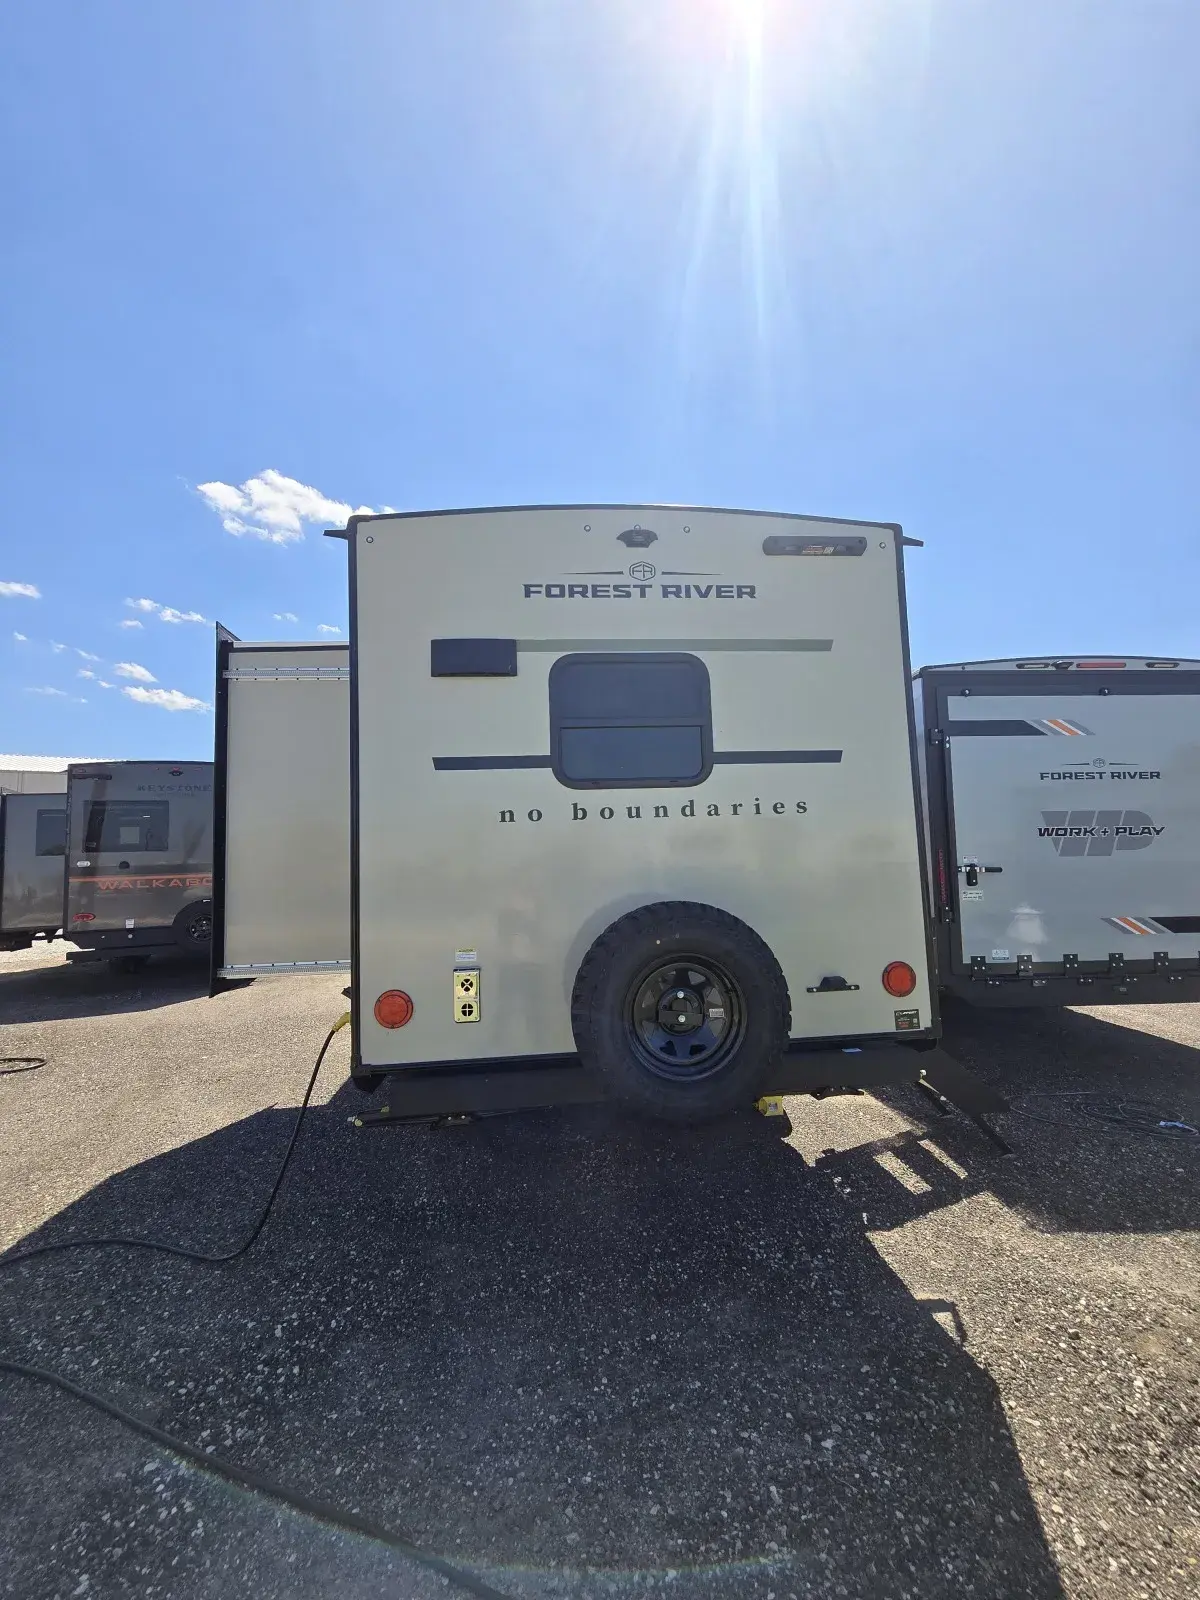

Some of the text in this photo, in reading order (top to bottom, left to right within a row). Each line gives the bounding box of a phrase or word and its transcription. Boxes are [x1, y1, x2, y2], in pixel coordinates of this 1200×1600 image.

[522, 583, 757, 599] FOREST RIVER
[1039, 771, 1161, 781] FOREST RIVER
[136, 784, 212, 792] KEYSTONE
[498, 797, 809, 823] no boundaries
[1037, 826, 1166, 837] WORK + PLAY
